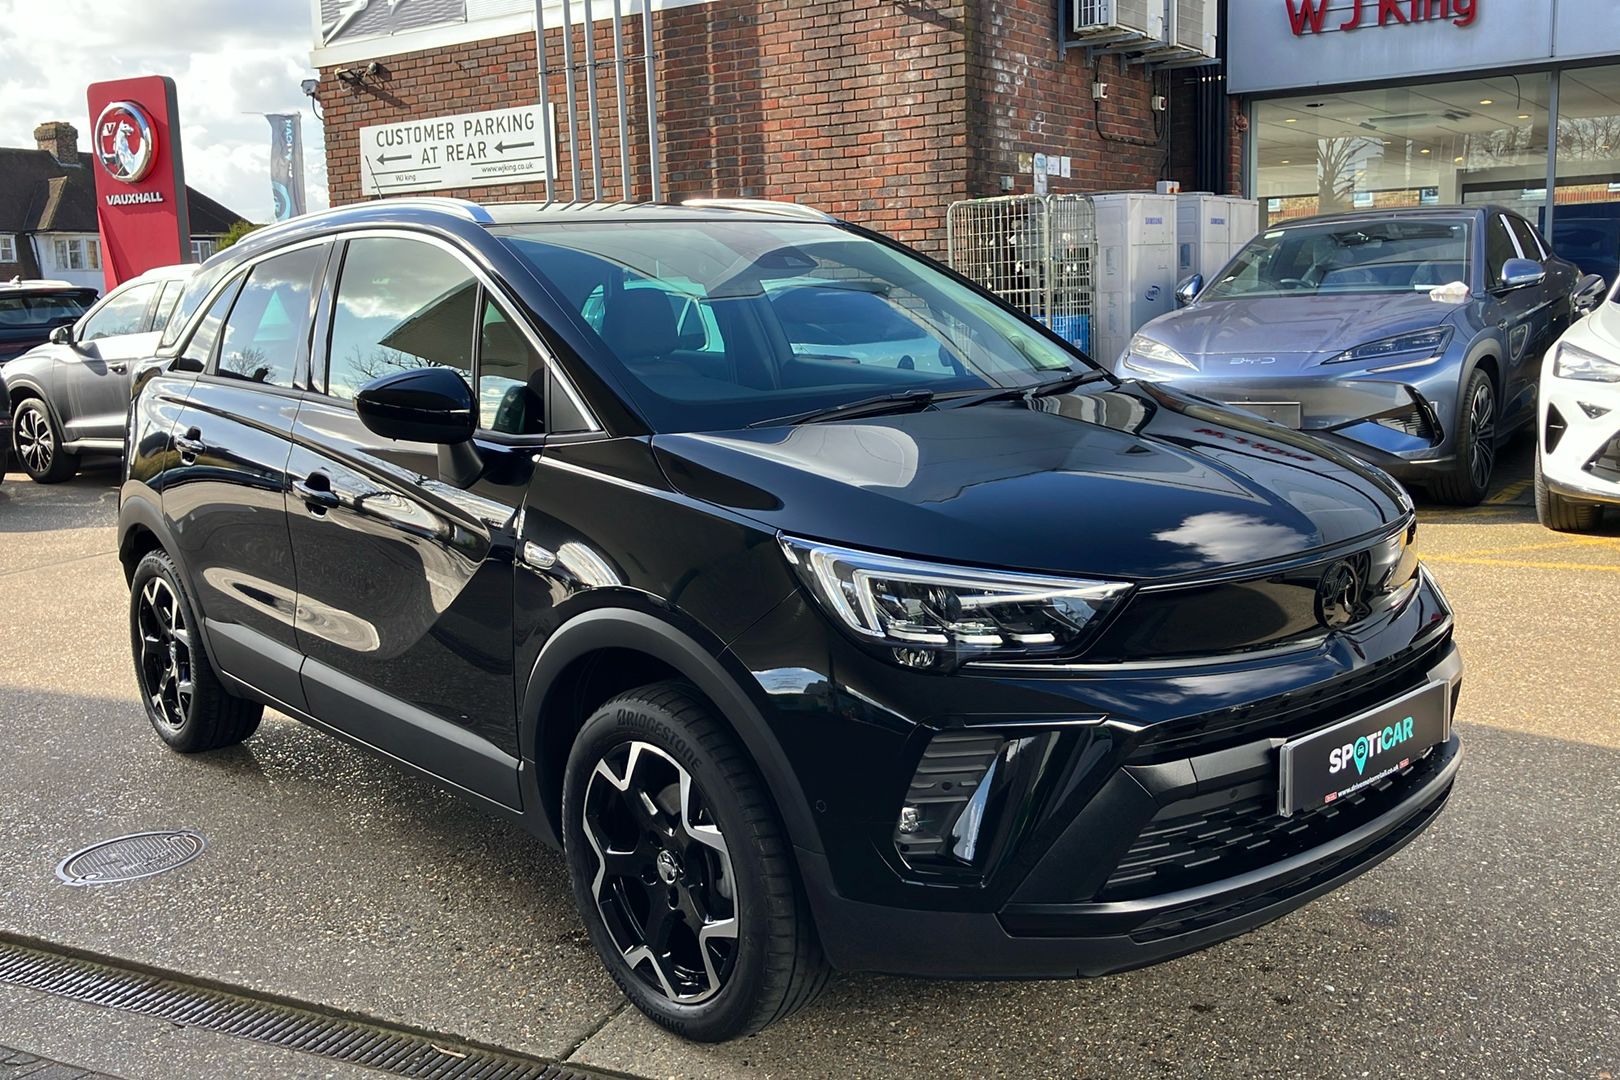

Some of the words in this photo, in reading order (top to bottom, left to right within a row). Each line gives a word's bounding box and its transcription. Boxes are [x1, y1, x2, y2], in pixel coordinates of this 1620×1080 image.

[1378, 0, 1477, 27] King
[376, 122, 455, 147] CUSTOMER
[464, 112, 535, 137] PARKING
[421, 147, 438, 164] AT
[446, 141, 487, 162] REAR
[481, 162, 534, 173] www.wjking.co.uk
[106, 192, 163, 205] VAUXHALL
[616, 708, 702, 771] BRIDGESTONE
